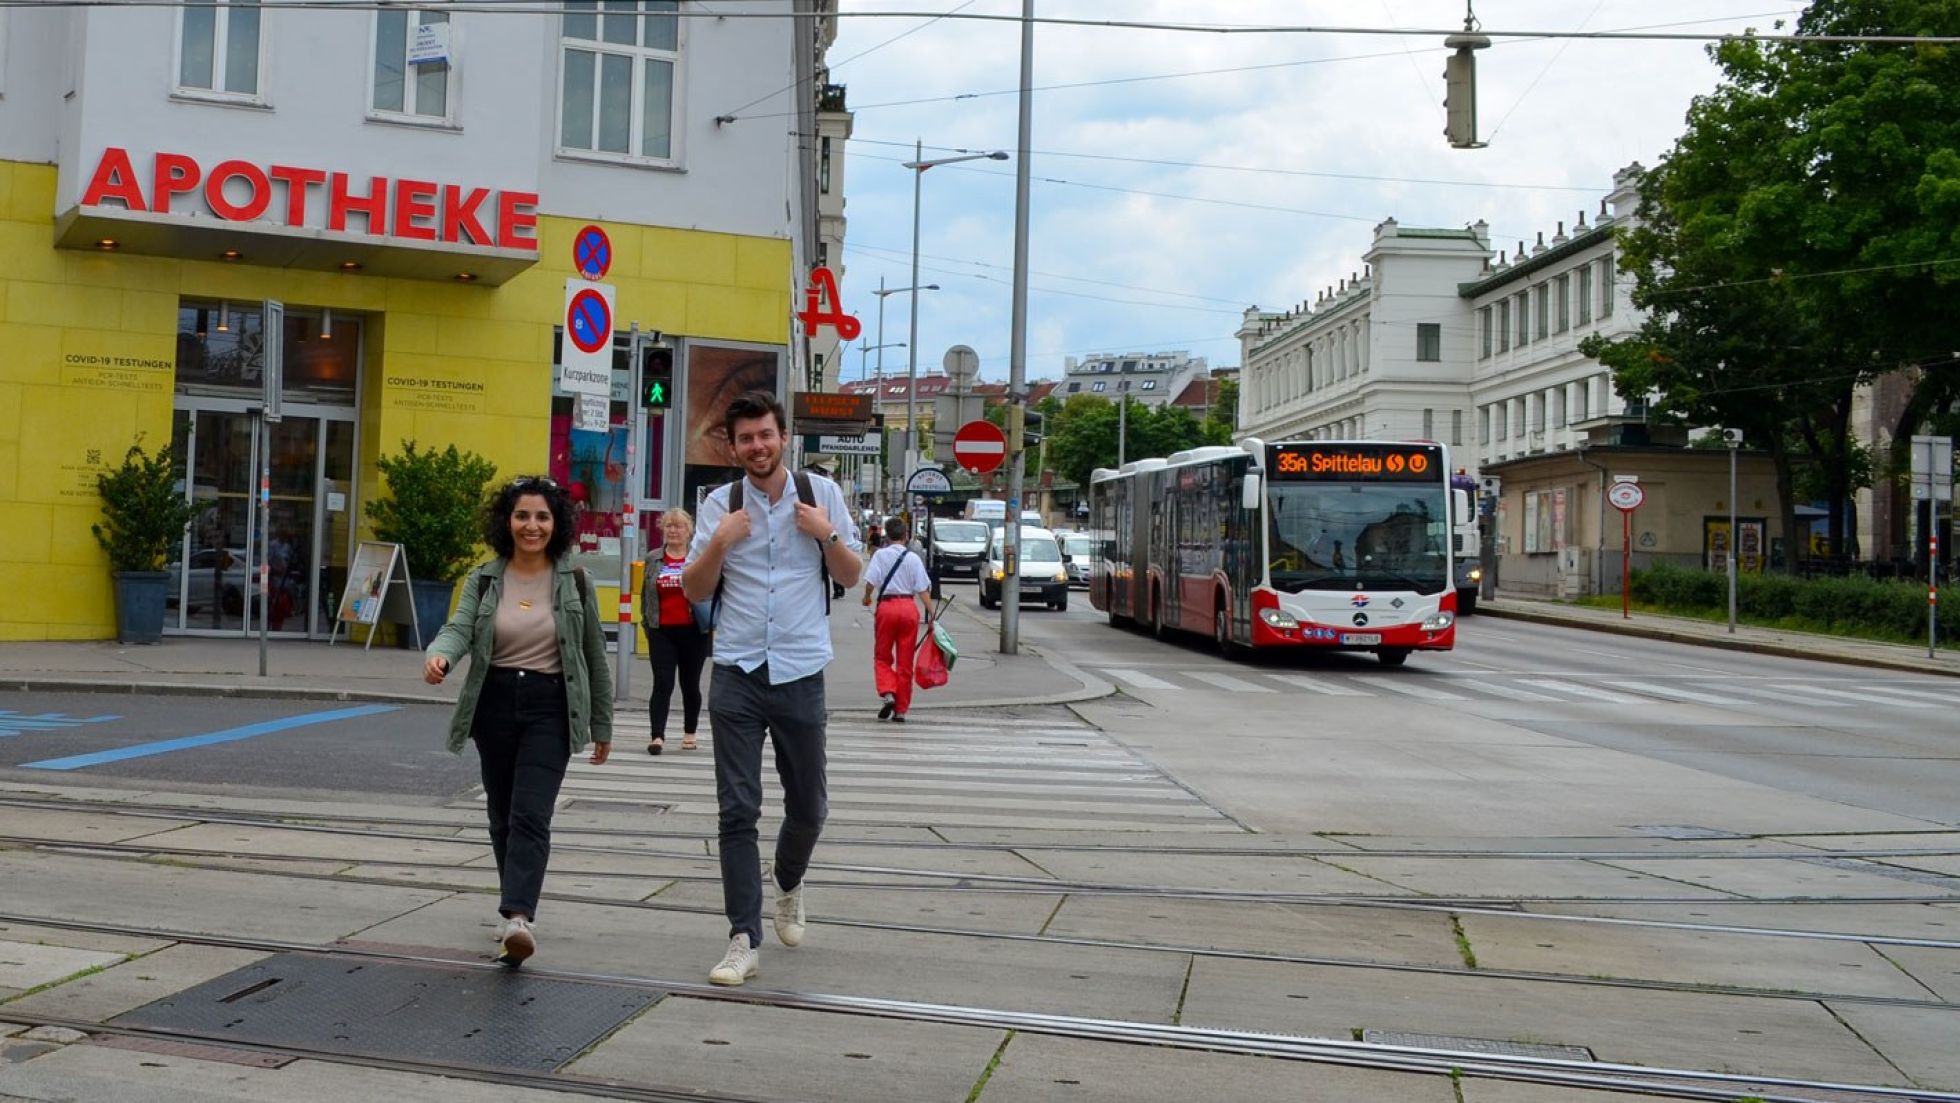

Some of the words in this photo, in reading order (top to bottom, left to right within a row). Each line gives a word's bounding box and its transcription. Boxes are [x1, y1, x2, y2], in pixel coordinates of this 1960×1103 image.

[81, 147, 539, 250] APOTHEKE
[65, 354, 111, 366] COVID-19
[113, 357, 172, 370] TESTUNGEN
[564, 366, 609, 385] Kurzparkzone
[387, 377, 429, 388] COVID-19
[431, 380, 485, 392] TESTUNGEN
[820, 443, 880, 452] PFANDDARLEHEN
[837, 435, 865, 444] AUTO
[1278, 452, 1308, 472] 35A
[1311, 453, 1382, 472] Spittelau
